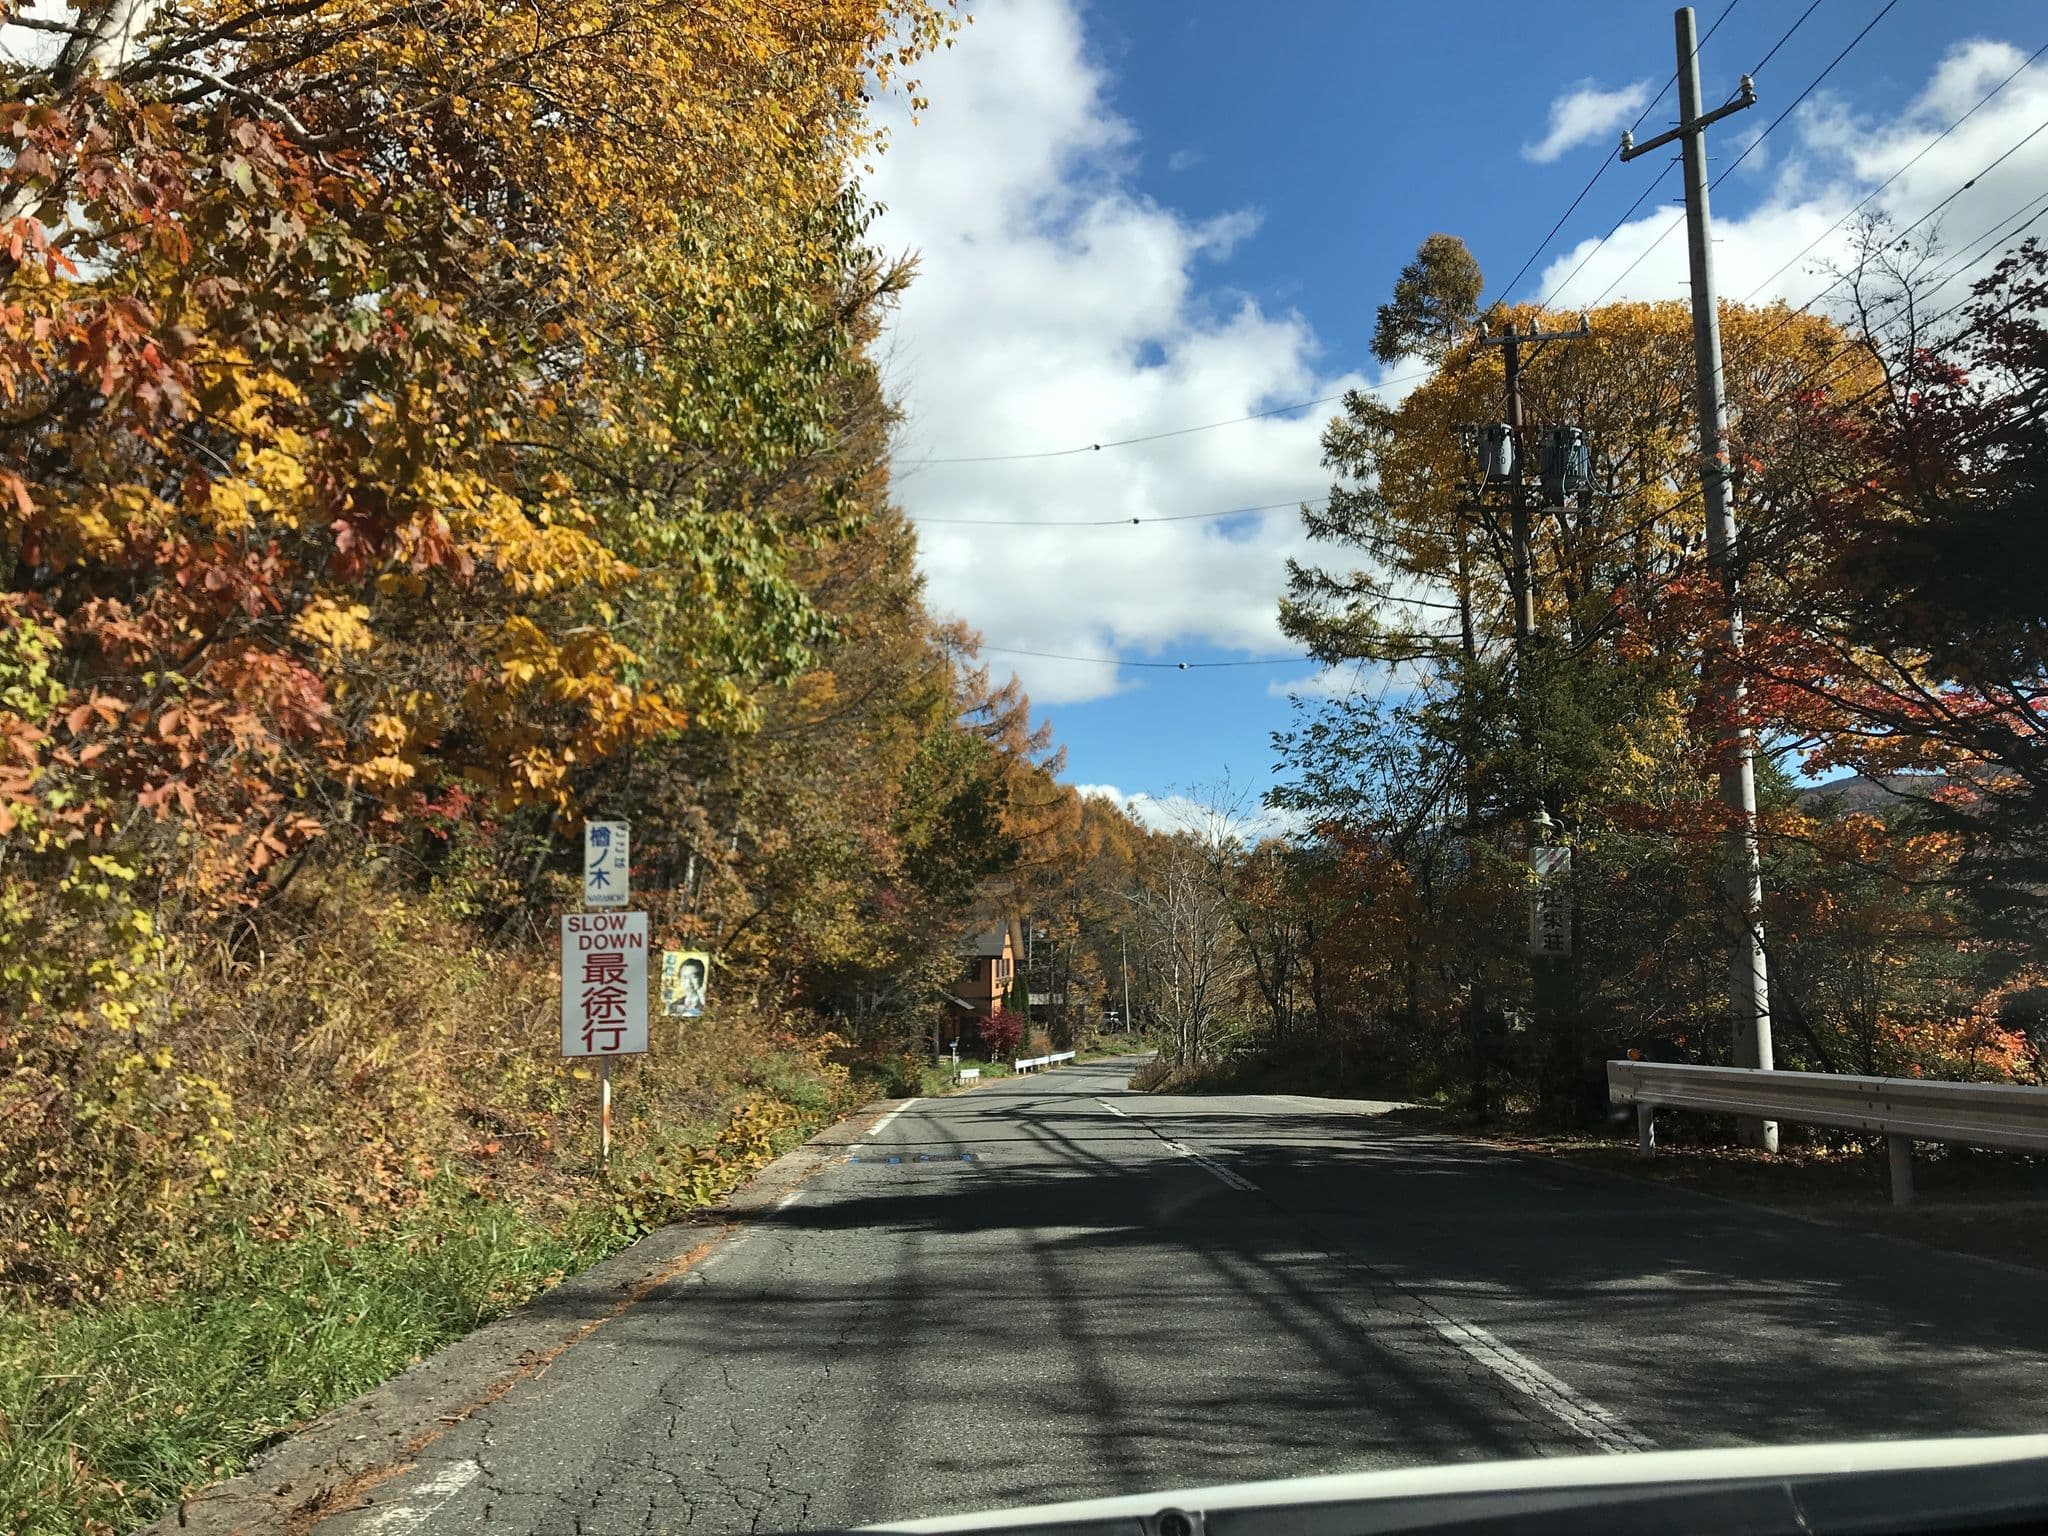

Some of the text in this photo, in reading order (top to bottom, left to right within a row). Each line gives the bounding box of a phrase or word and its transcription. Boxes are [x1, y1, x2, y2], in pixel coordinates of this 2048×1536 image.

[567, 914, 628, 933] SLOW
[578, 932, 643, 951] DOWN
[580, 952, 629, 1053] 最徐行
